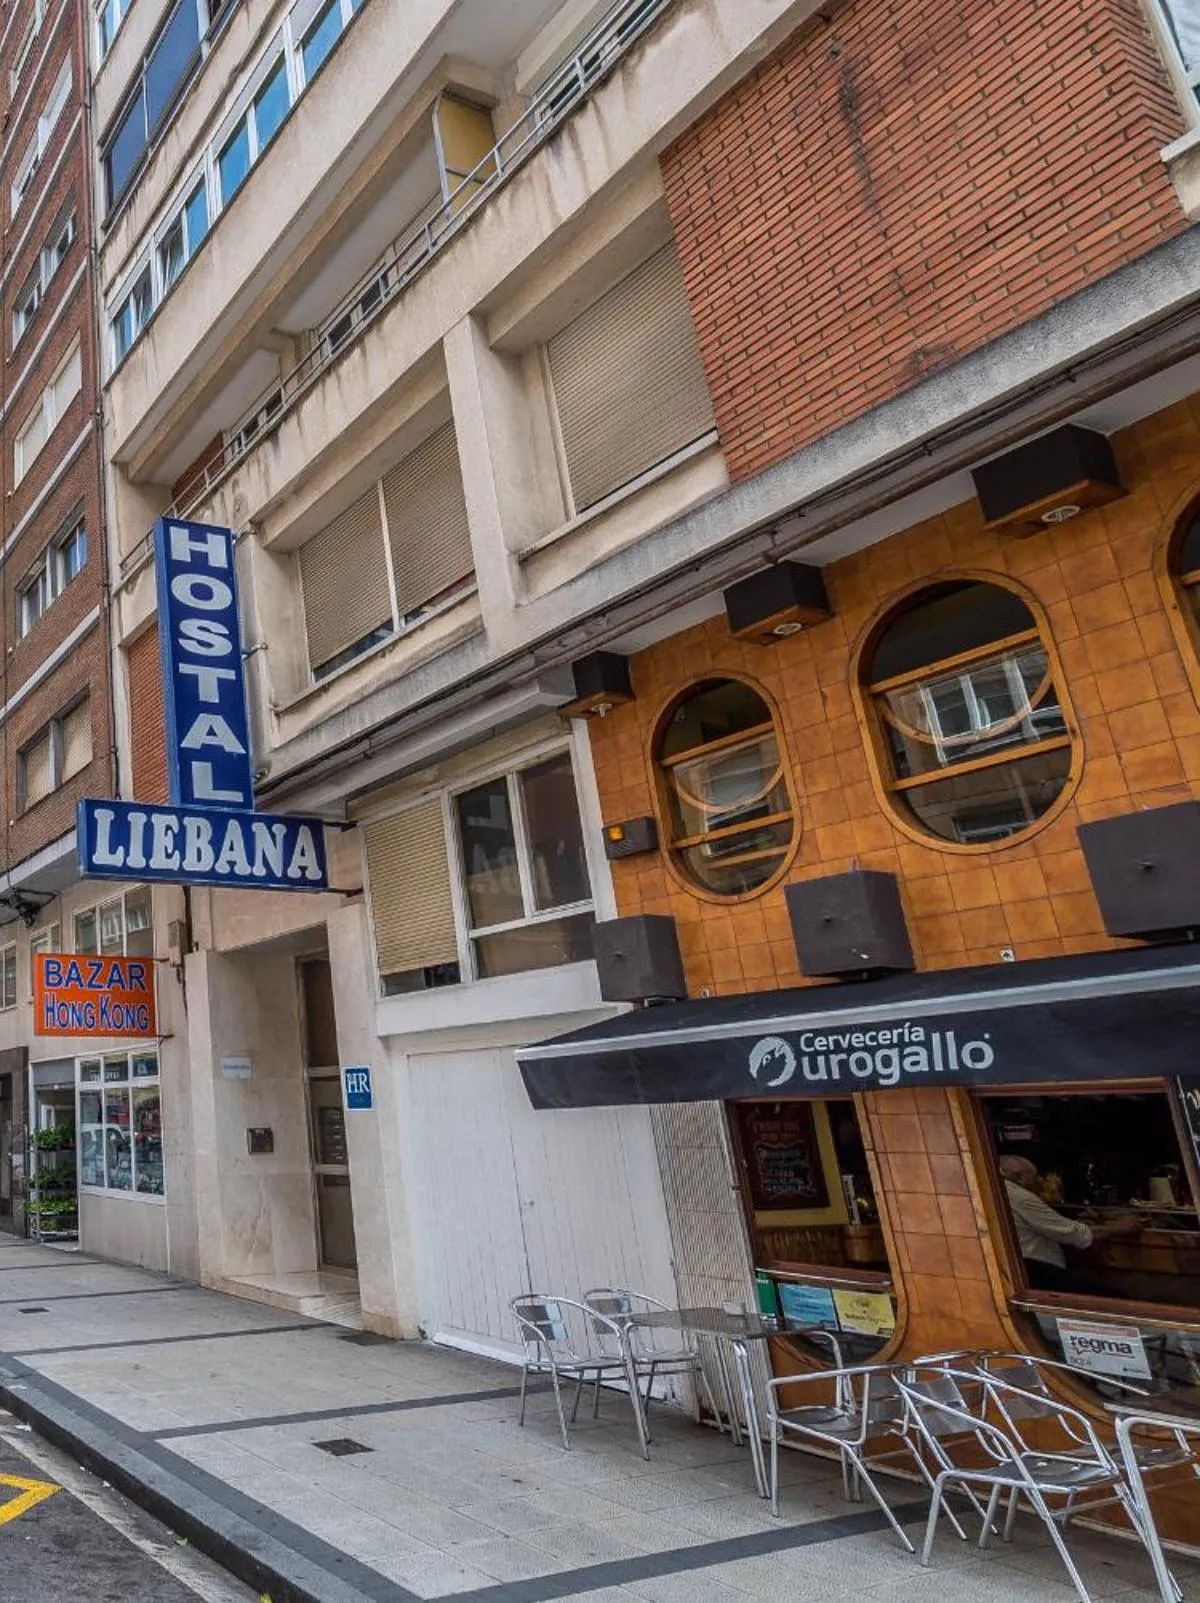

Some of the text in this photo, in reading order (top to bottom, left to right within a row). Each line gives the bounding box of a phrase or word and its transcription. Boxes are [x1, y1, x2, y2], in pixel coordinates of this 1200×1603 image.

[169, 526, 246, 802] HOSTAL
[92, 809, 322, 880] LIEBANA
[45, 959, 146, 991] BAZAR
[45, 992, 149, 1031] HONG KONG
[800, 1022, 925, 1052] Cervecería
[802, 1031, 995, 1085] urogallo
[347, 1073, 370, 1093] HR
[1070, 1335, 1133, 1355] regma
